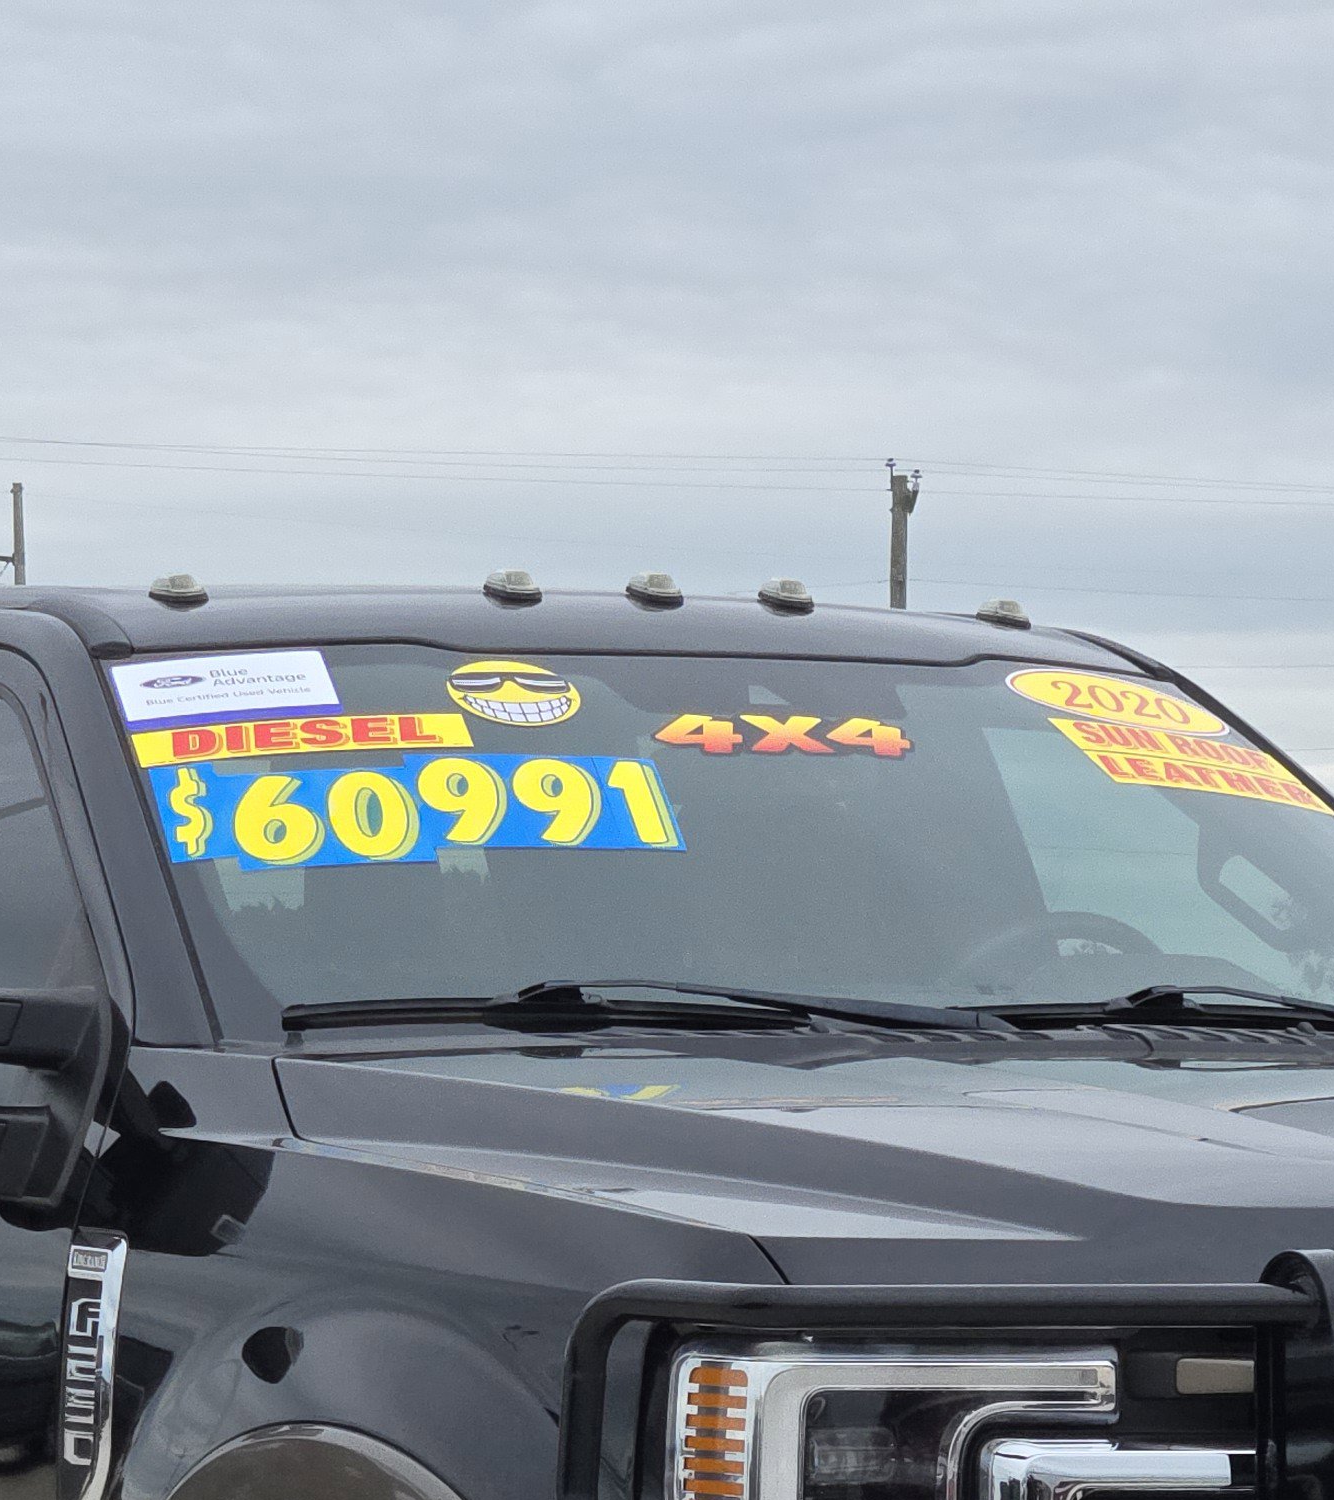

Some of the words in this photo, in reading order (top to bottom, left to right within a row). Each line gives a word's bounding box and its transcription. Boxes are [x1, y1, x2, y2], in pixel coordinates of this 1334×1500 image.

[209, 667, 248, 678] Blue
[213, 673, 306, 686] Advantage
[1051, 680, 1191, 725] 2020
[170, 716, 443, 757] DIESEL
[653, 711, 914, 758] 4X4
[1071, 721, 1169, 755] SUN
[1166, 735, 1275, 773] ROOF
[1096, 755, 1323, 809] LEATHER
[169, 757, 680, 866] $60991
